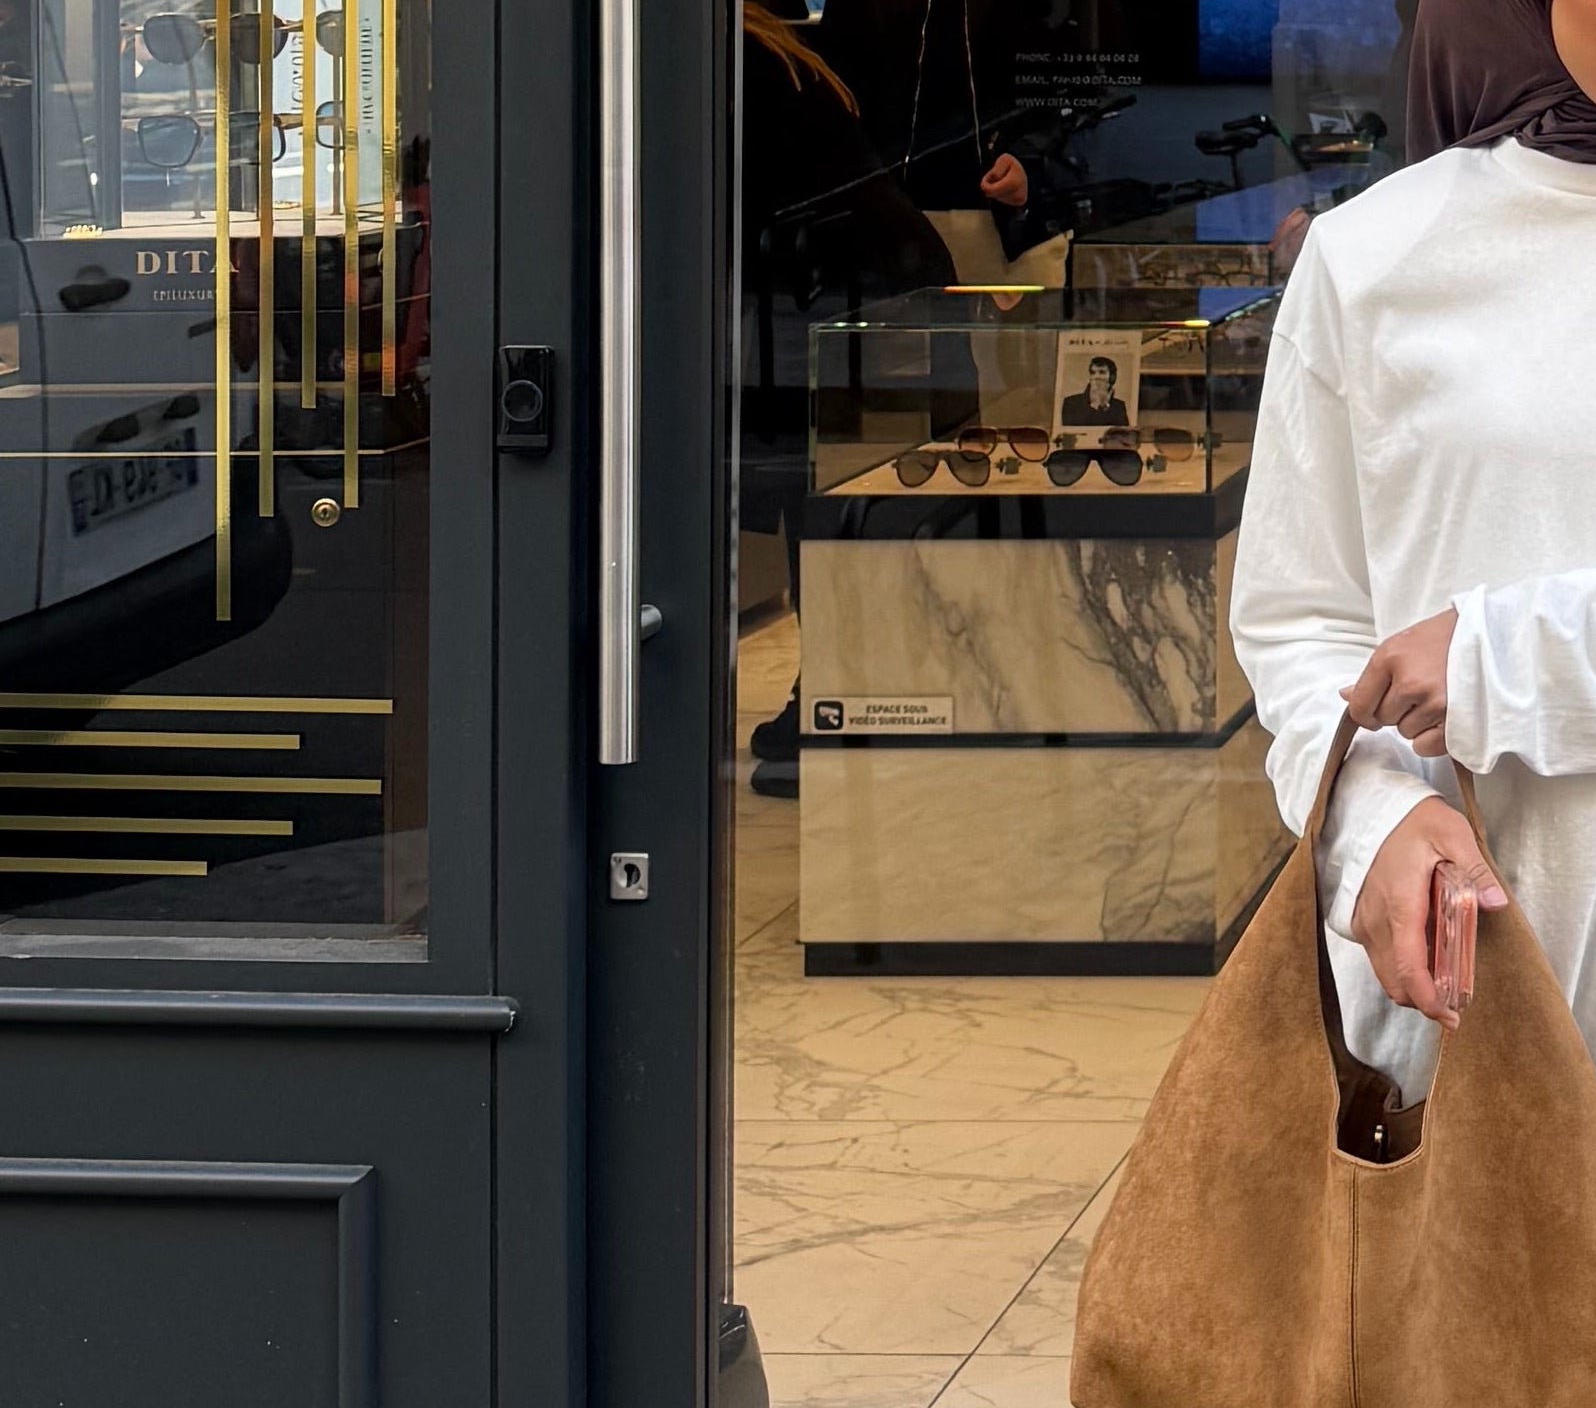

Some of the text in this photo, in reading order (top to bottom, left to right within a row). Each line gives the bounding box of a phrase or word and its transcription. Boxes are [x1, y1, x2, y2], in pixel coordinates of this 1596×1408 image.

[866, 704, 928, 714] ESPACE SOUS
[849, 714, 947, 726] VIDÉO SURVEILLANCE
